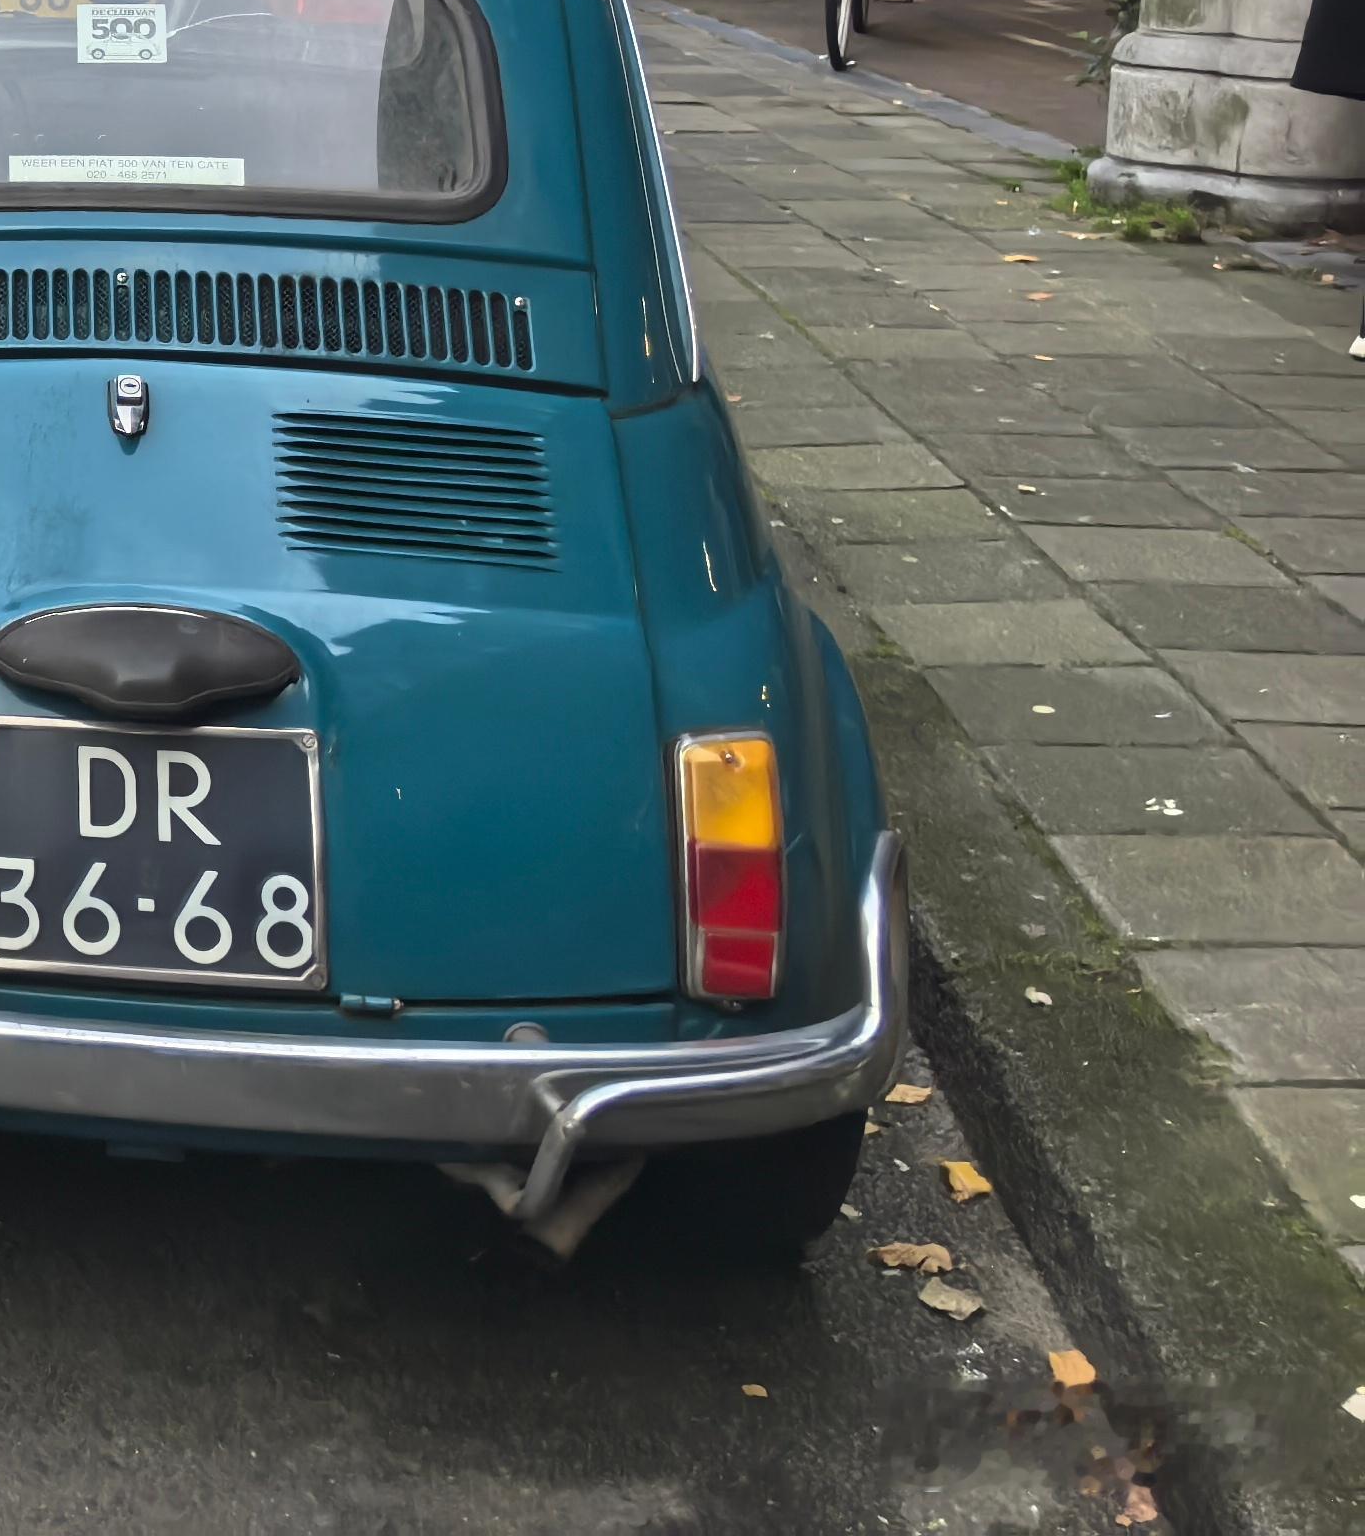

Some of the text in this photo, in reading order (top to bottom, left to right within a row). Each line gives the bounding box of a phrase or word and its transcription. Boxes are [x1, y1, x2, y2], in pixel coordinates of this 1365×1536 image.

[92, 18, 157, 40] 500
[21, 159, 57, 168] WEER
[60, 159, 85, 168] EEN
[89, 159, 114, 169] FIAT
[118, 159, 138, 168] 500
[141, 159, 166, 169] VAN
[170, 160, 193, 169] TEN
[86, 170, 107, 179] 020
[77, 745, 222, 846] DR
